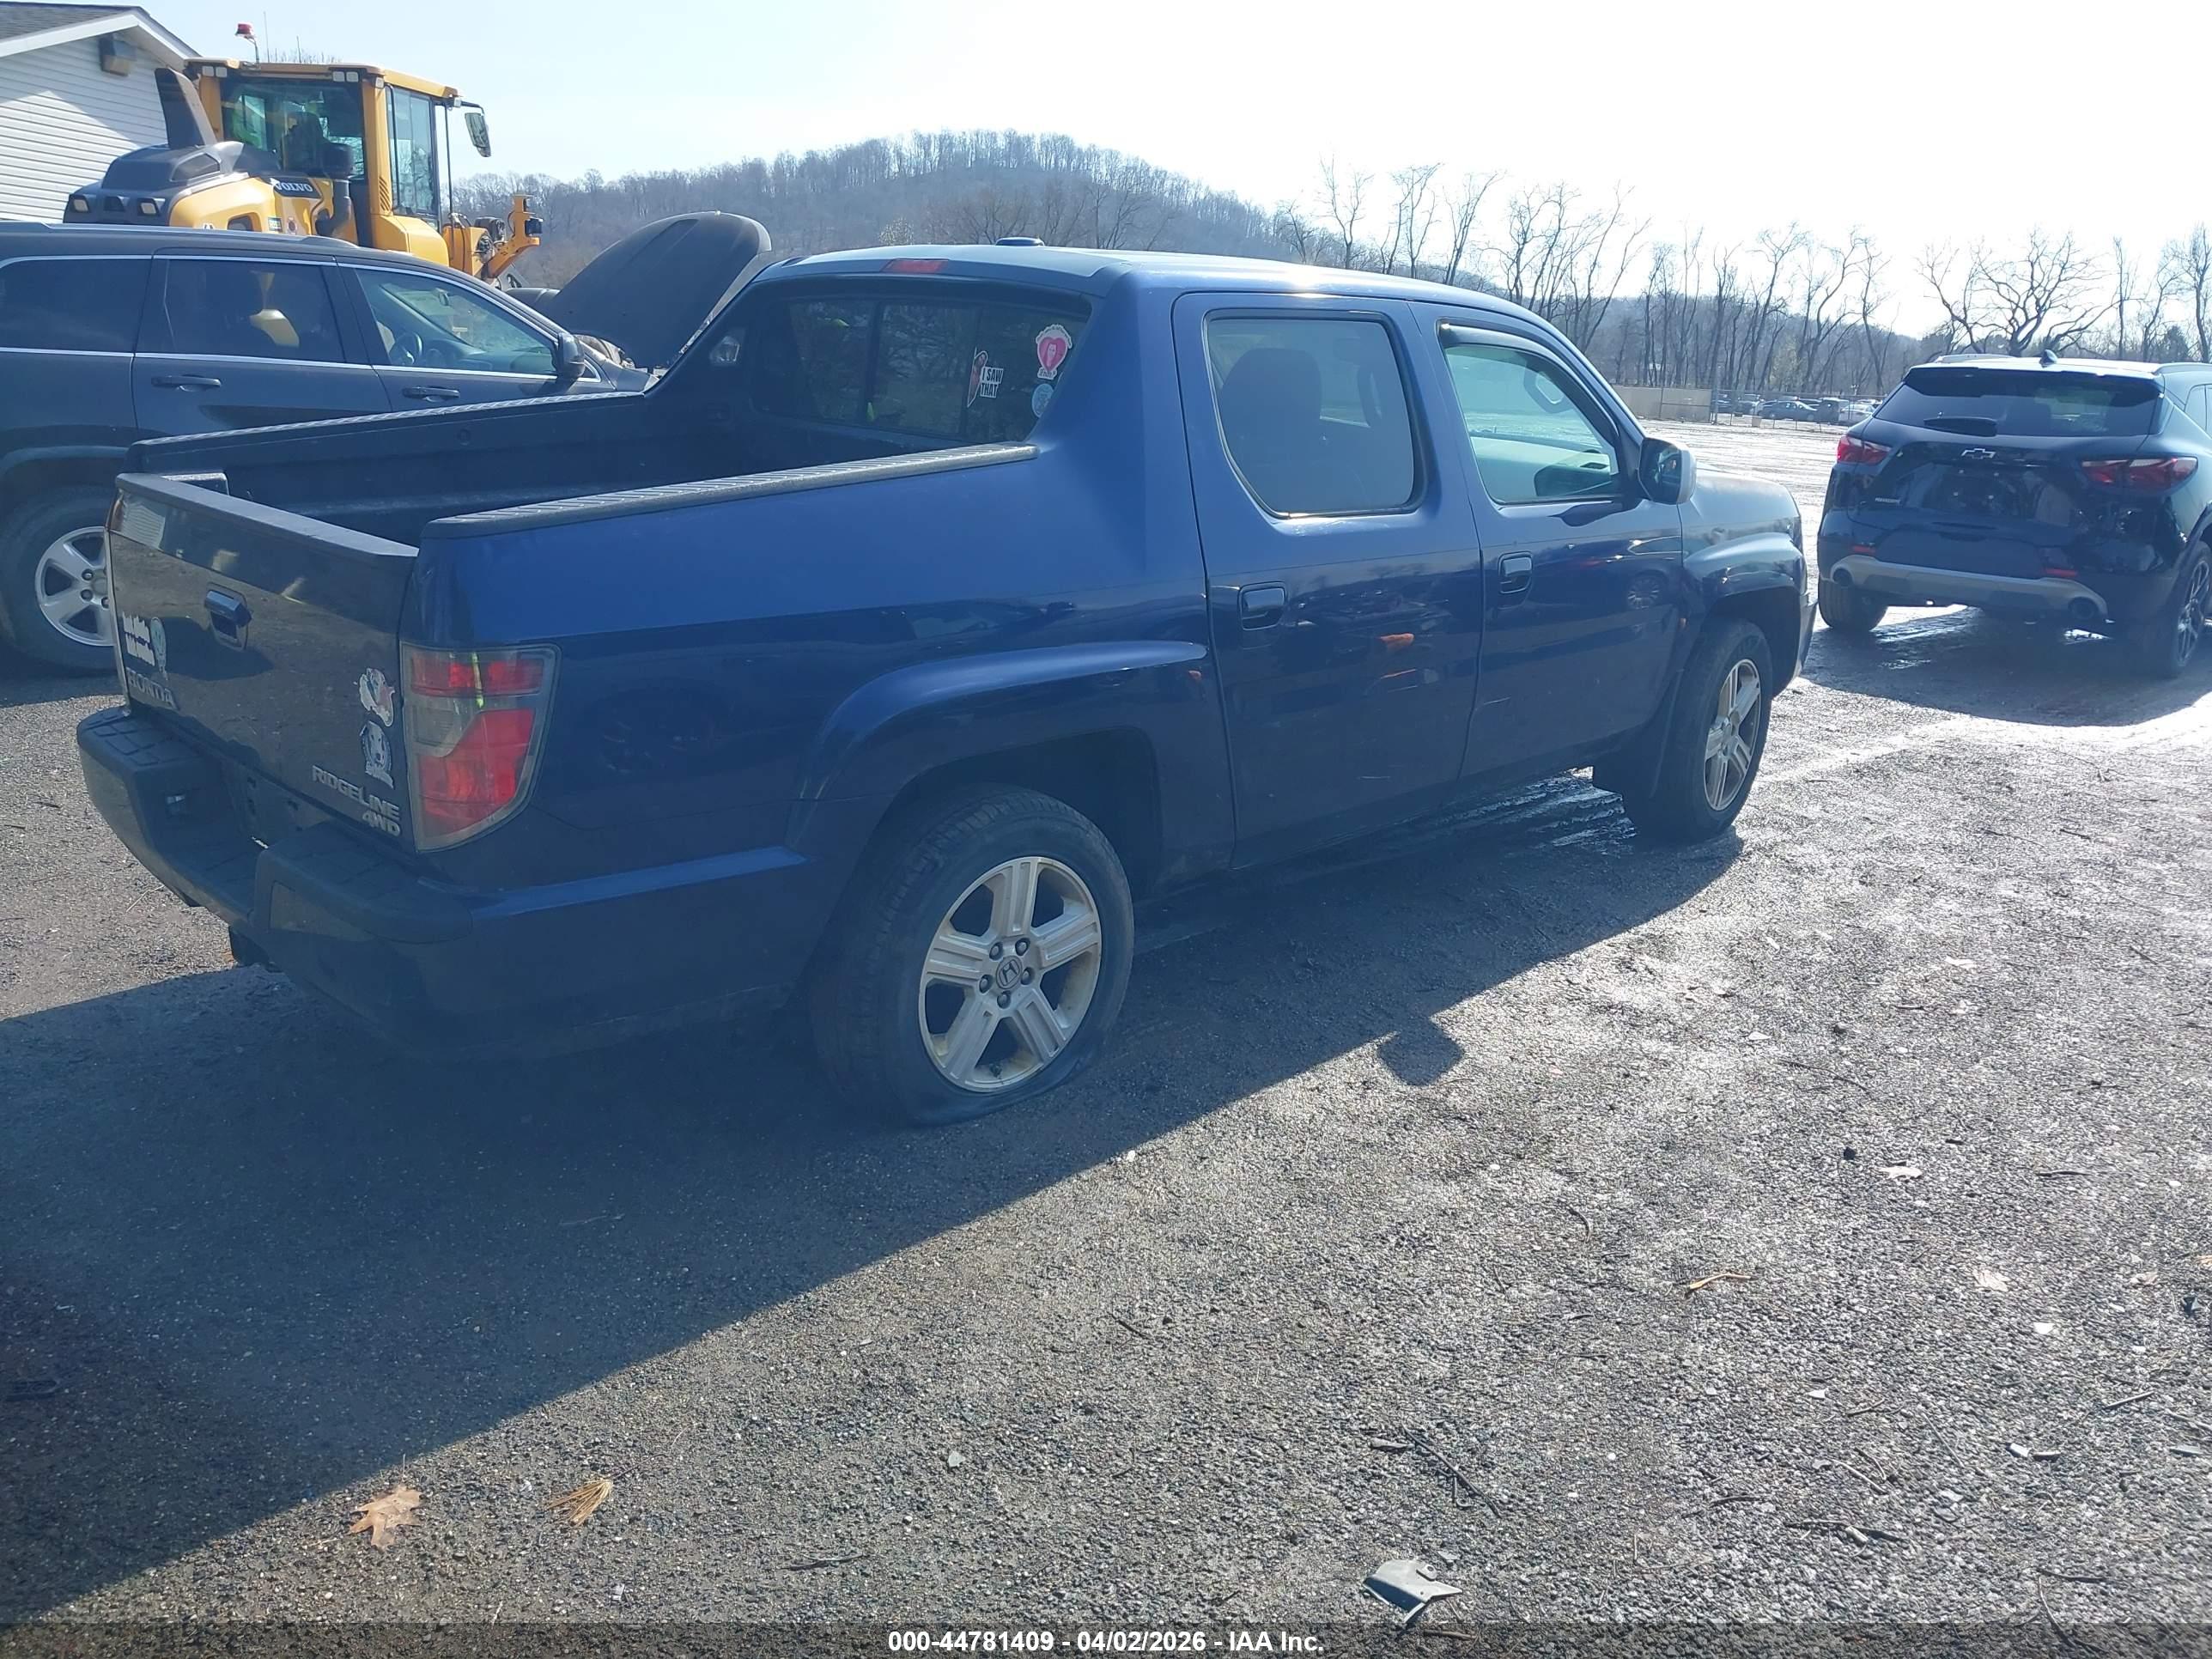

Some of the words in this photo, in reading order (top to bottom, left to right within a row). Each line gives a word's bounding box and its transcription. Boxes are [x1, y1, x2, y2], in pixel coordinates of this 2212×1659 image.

[275, 180, 313, 192] VOLVO
[981, 368, 986, 380] I
[987, 368, 1003, 383] SAW
[981, 382, 998, 398] THAT
[313, 765, 400, 822] RIDGELINE
[362, 810, 400, 836] 4WD
